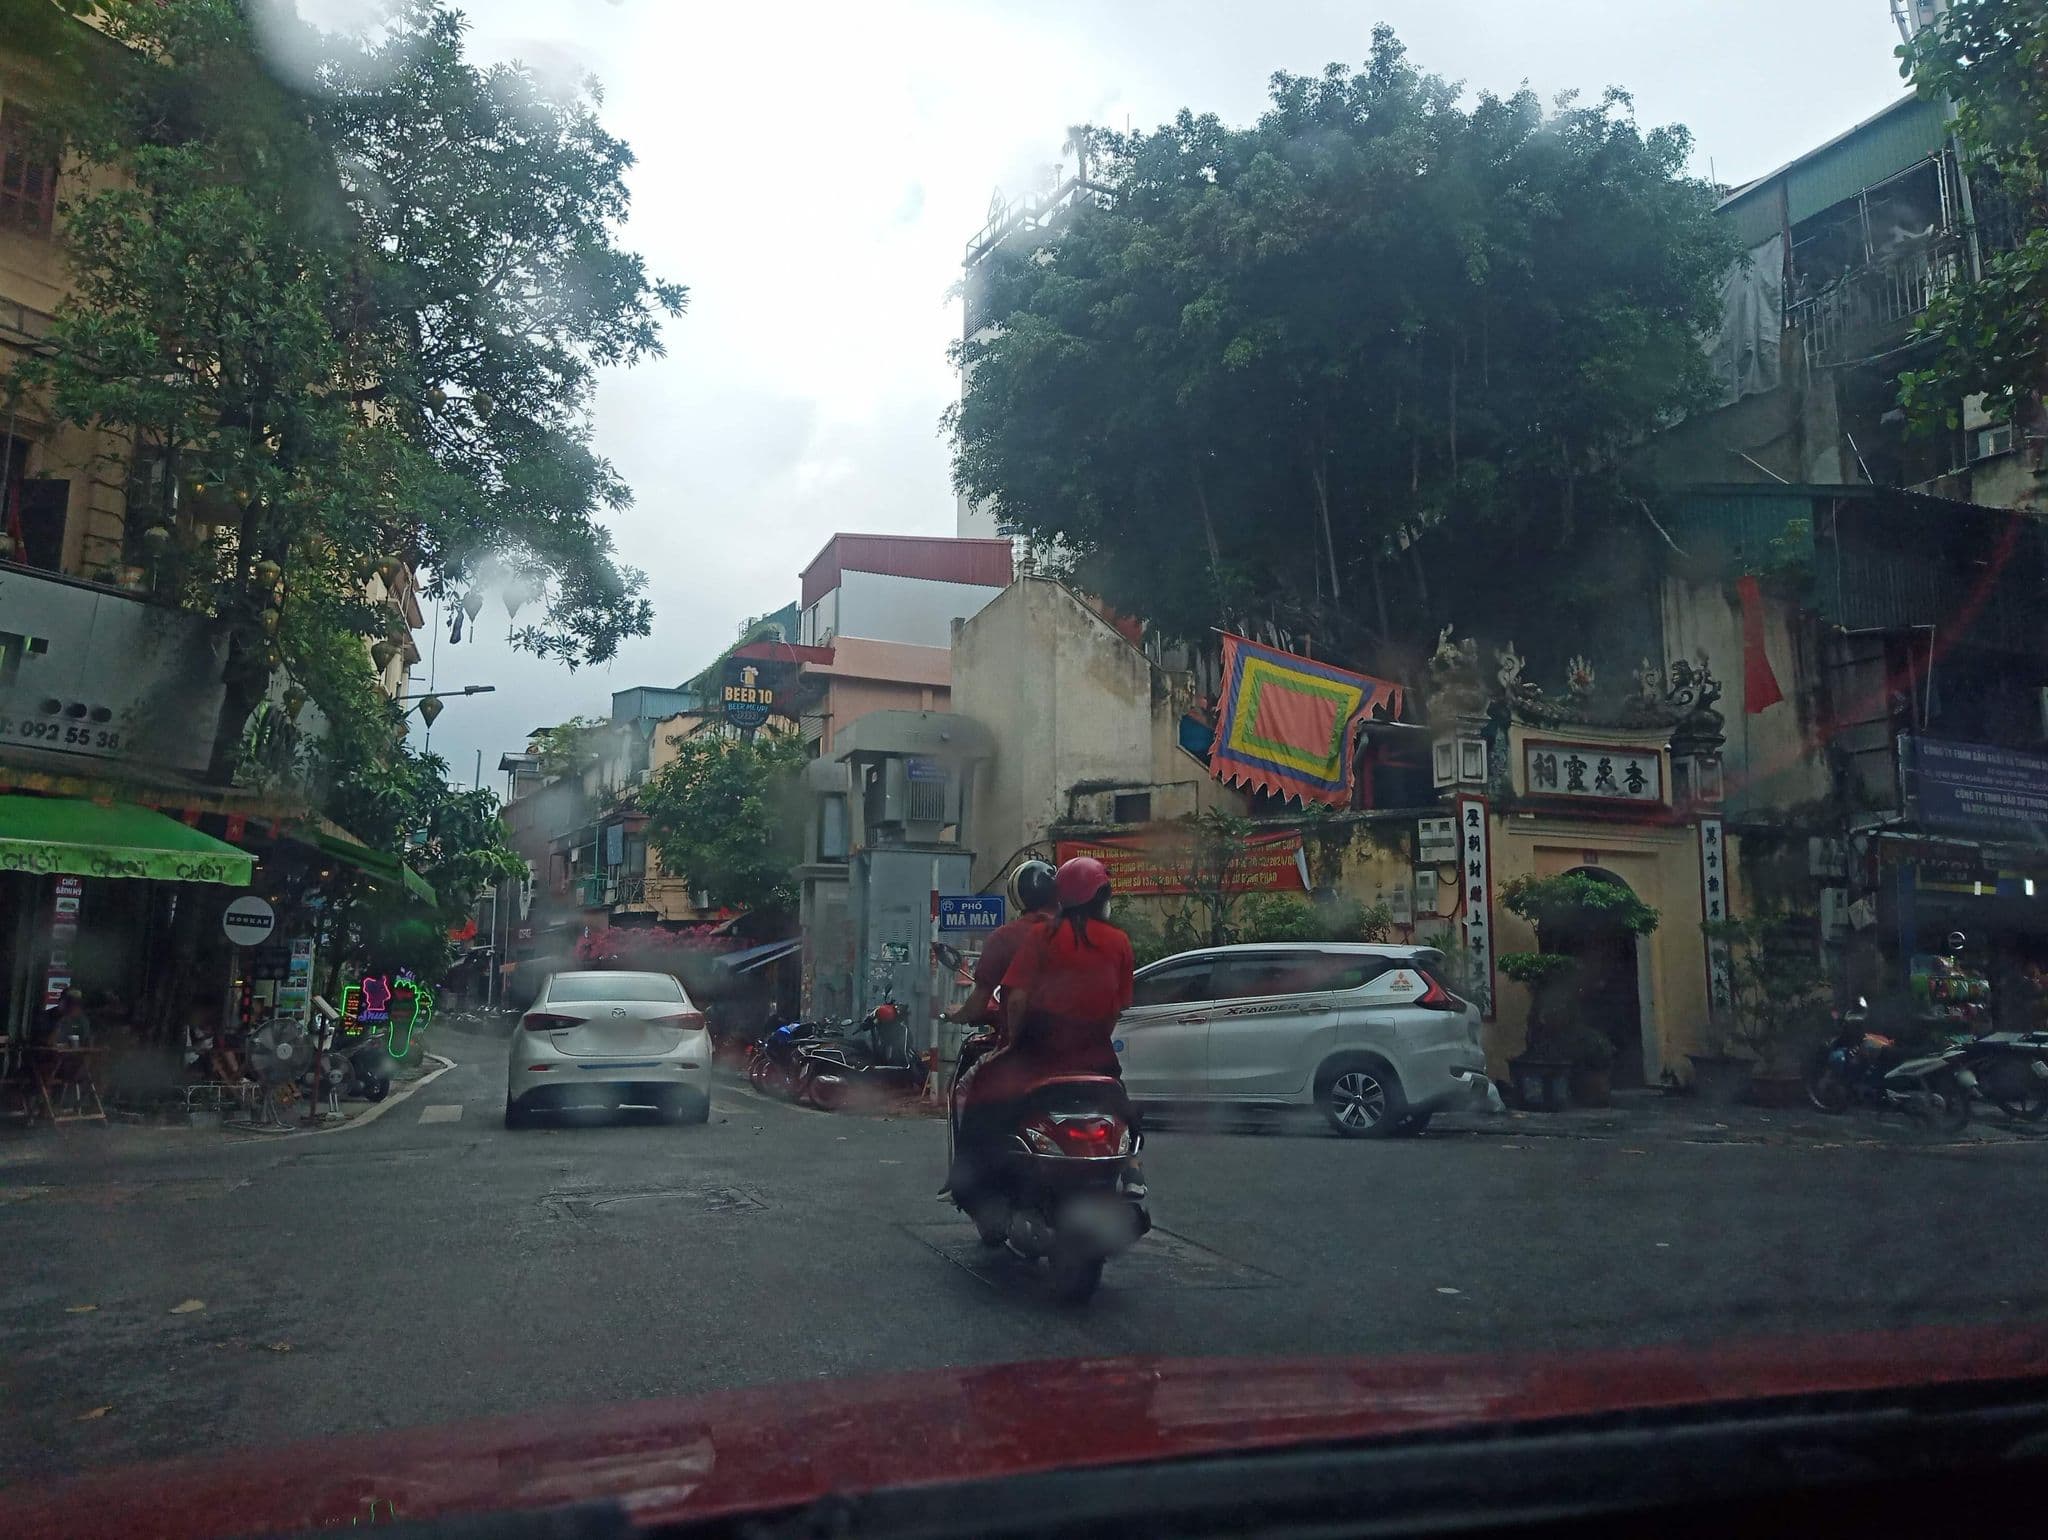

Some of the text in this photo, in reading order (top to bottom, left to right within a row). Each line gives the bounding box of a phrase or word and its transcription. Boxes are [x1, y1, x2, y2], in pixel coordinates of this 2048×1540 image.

[725, 686, 773, 704] BEER 10
[20, 721, 60, 741] 092
[64, 727, 90, 746] 55
[961, 901, 982, 910] PHỐ
[946, 910, 998, 926] MÃ MÂY
[1224, 1003, 1300, 1016] XPANDER
